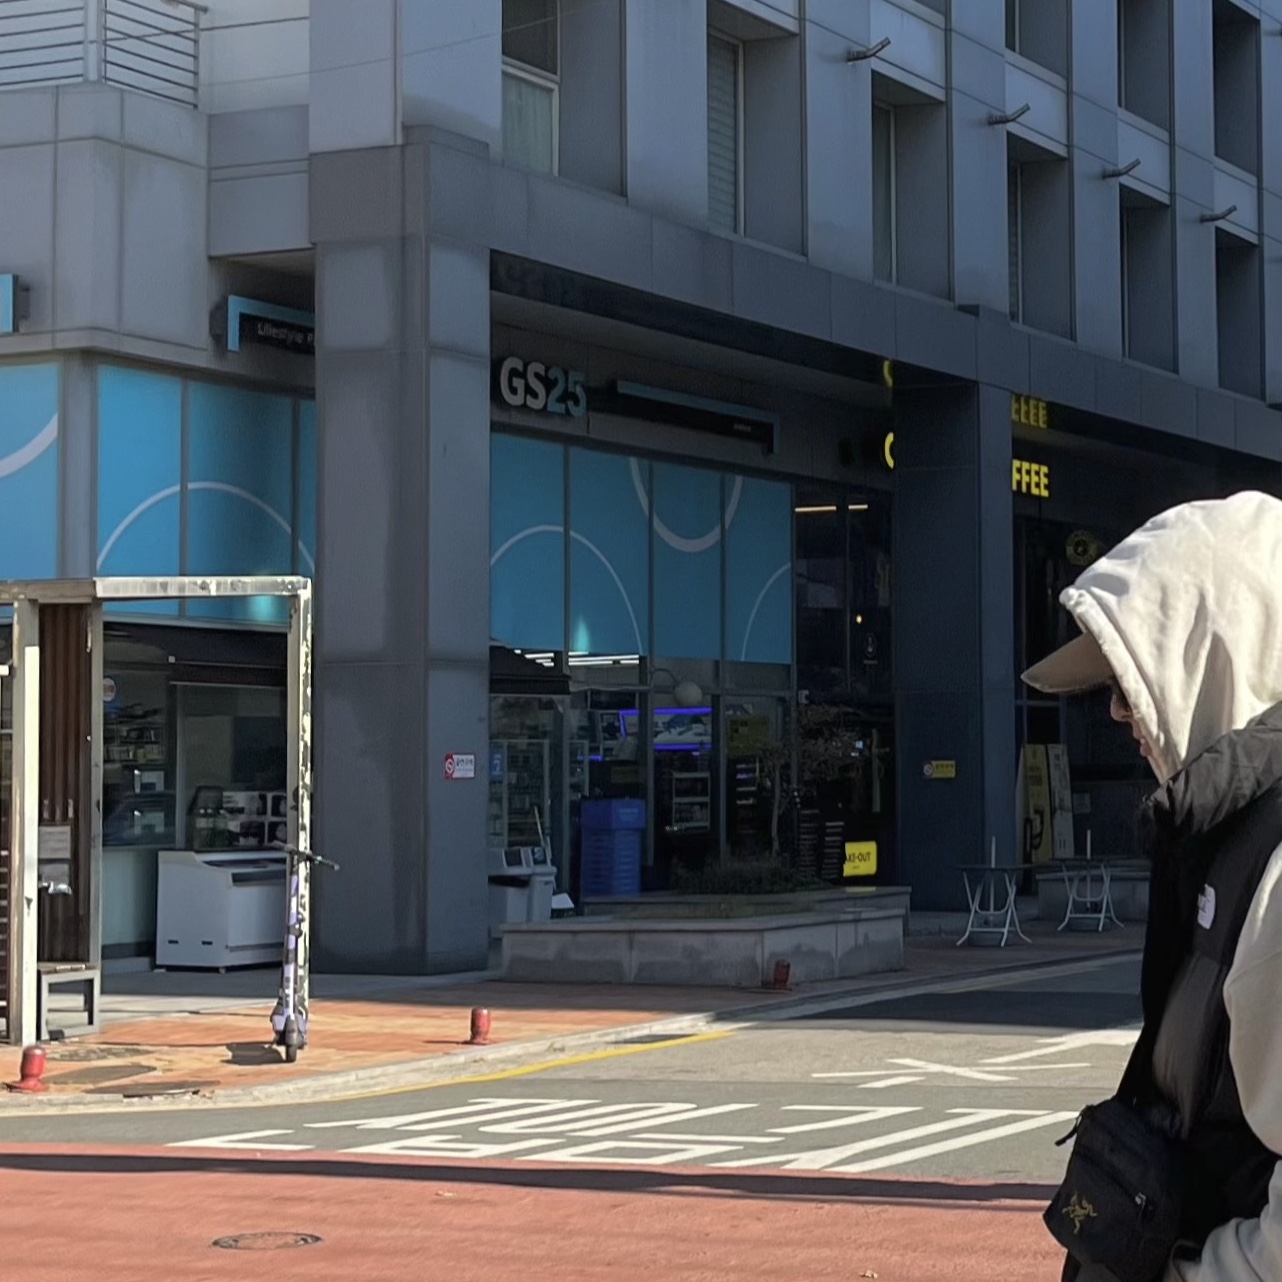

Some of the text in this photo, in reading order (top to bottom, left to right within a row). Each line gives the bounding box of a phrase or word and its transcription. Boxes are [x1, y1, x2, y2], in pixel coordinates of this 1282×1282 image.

[500, 356, 588, 418] GS25
[1013, 459, 1049, 497] FFEE
[164, 1097, 1081, 1173] 진입금지
